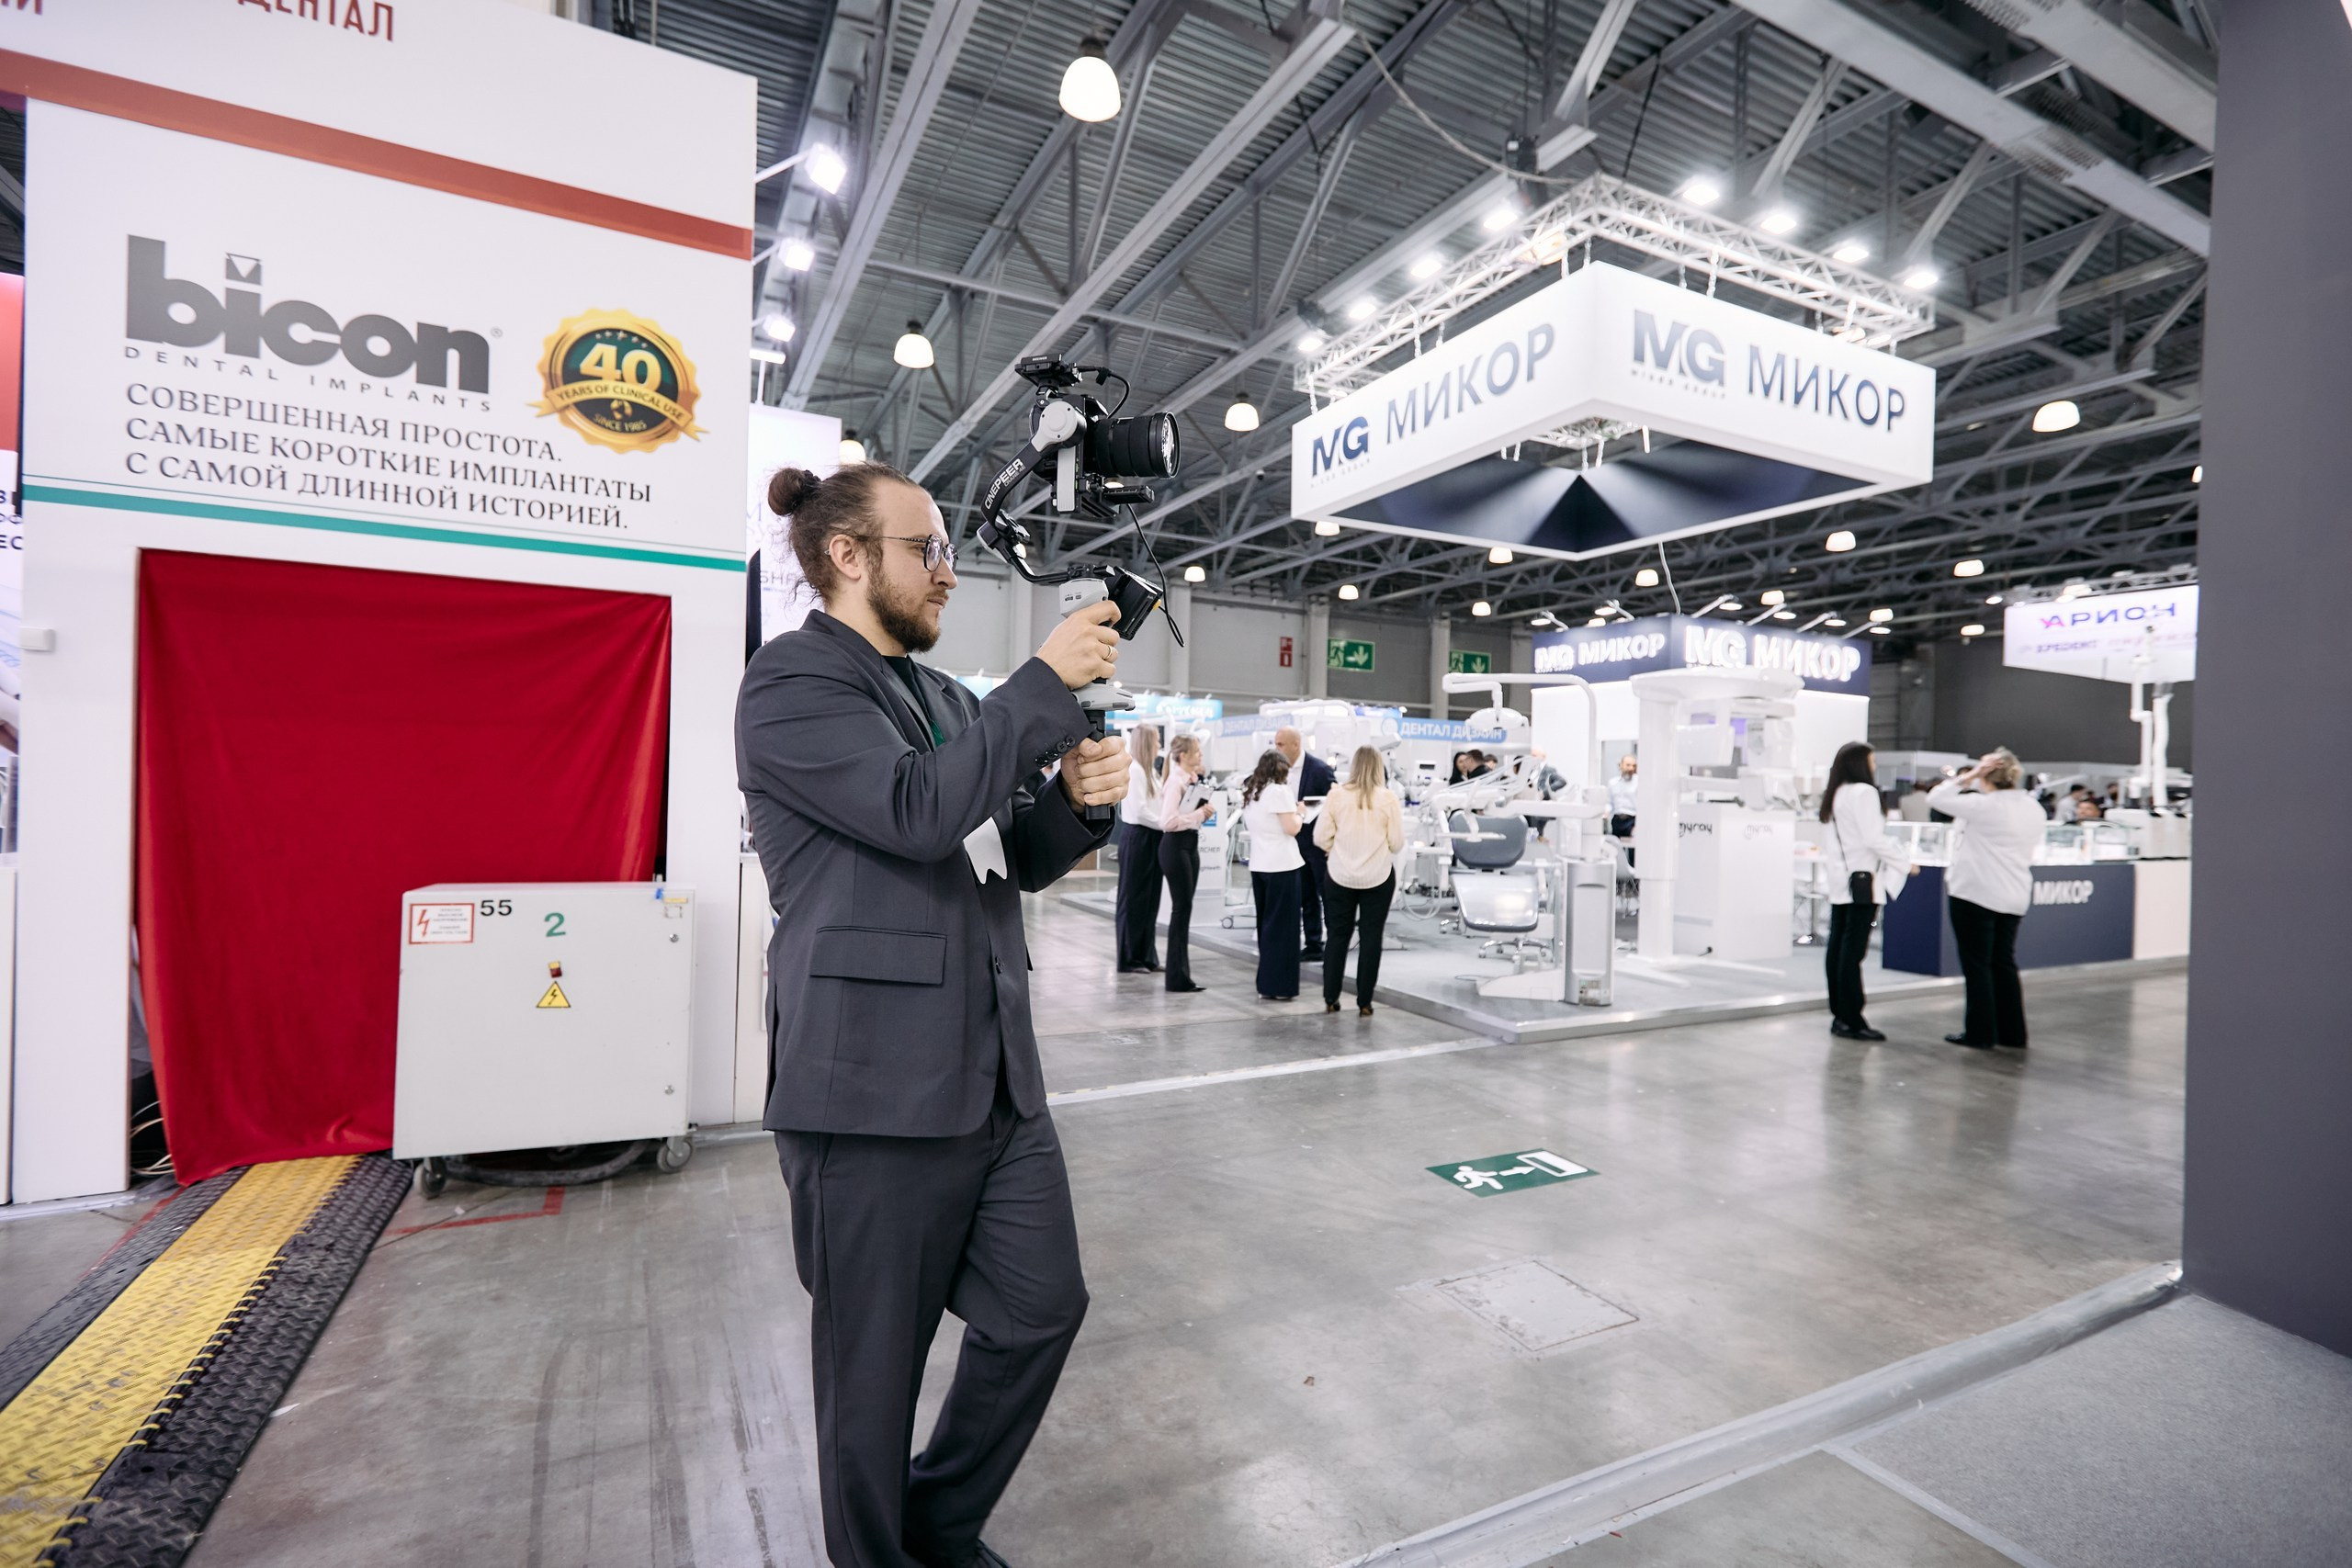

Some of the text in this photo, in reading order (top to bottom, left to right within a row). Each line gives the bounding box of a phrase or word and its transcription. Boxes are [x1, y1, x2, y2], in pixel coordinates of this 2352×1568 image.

[126, 233, 491, 395] bicon
[124, 345, 492, 413] DENTAL IMPLANTS
[579, 342, 662, 393] 40
[1386, 322, 1555, 446] МИКОР
[1748, 344, 1905, 433] МИКОР
[126, 382, 563, 462] СОВЕРШЕННАЯ ПРОСТОТА.
[557, 385, 684, 420] YEARS OF CLINICAL USE
[593, 413, 622, 432] SINCE
[126, 417, 652, 503] САМЫЕ КОРОТКИЕ ИМПЛАНТАТЫ
[984, 457, 1024, 510] CINEPEER
[125, 452, 628, 530] С САМОЙ ДЛИННОЙ ИСТОРИЕЙ.
[1577, 633, 1665, 666] МИКОР
[1754, 634, 1861, 682] МИКОР
[1400, 722, 1451, 738] ДЕНТАЛ
[480, 899, 513, 917] 55
[2033, 880, 2094, 906] МИКОР
[543, 912, 567, 937] 2
